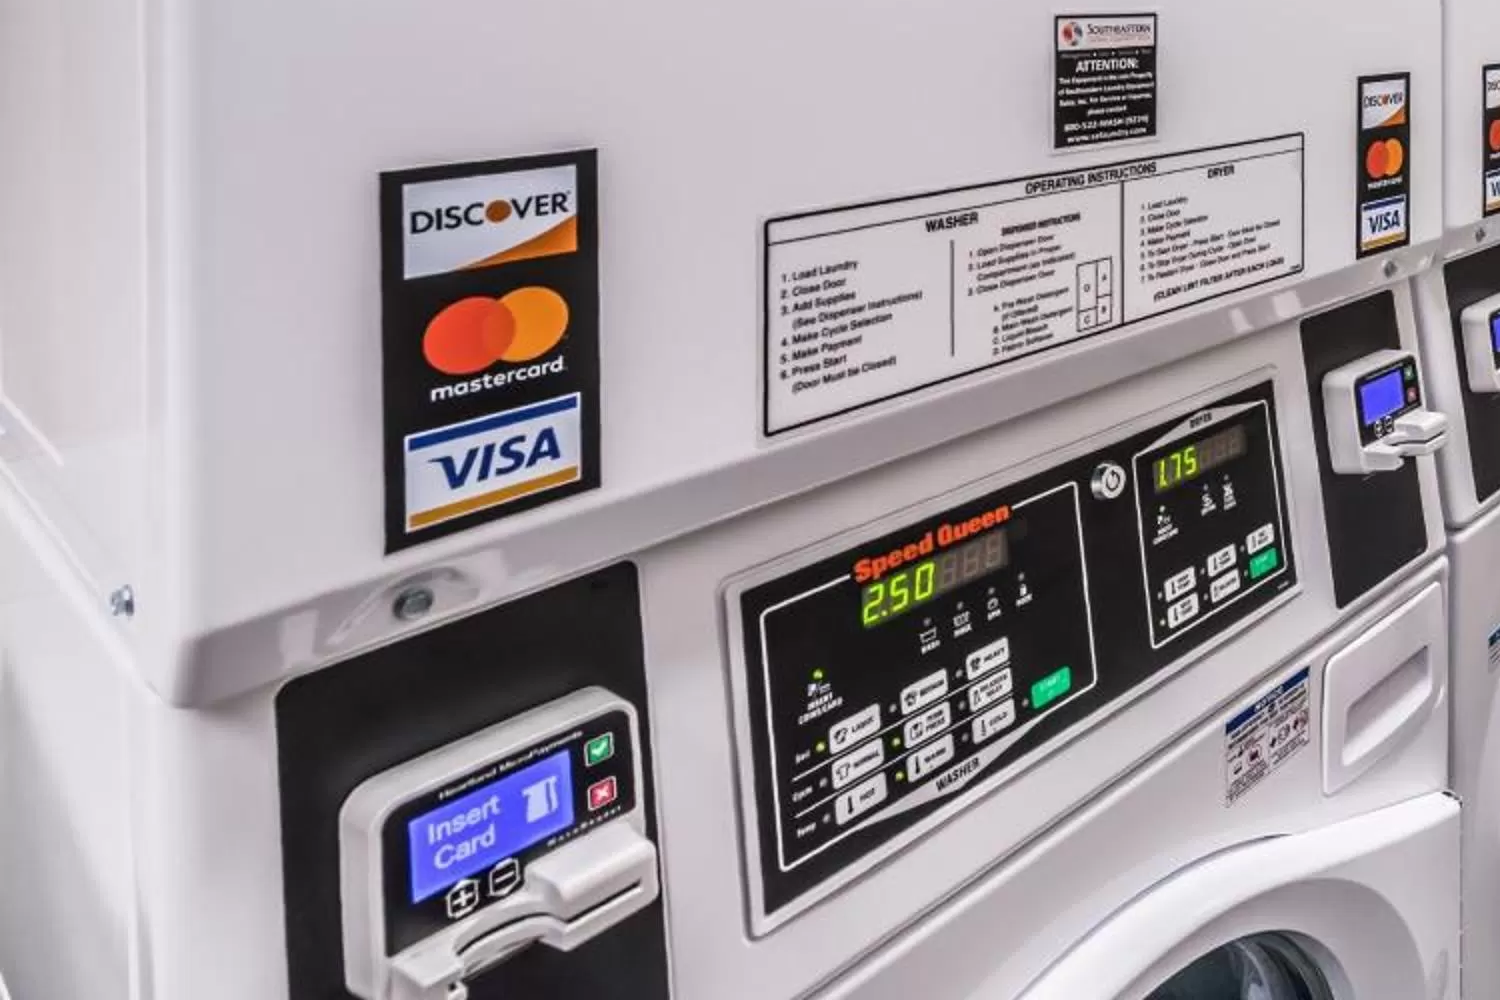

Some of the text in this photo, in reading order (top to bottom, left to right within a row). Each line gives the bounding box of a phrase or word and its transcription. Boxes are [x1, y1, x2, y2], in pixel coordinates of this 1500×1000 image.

[1076, 58, 1139, 73] ATTENTION:
[1025, 162, 1157, 195] OPERATING INSTRUCTIONS
[1207, 164, 1235, 179] DRYER
[410, 191, 570, 235] DISCOVER
[925, 212, 979, 232] WASHER
[1369, 210, 1400, 234] VISA
[782, 261, 859, 282] 1. Load Laundry
[792, 284, 820, 296] Close
[823, 279, 847, 290] Door
[793, 300, 813, 311] Add
[815, 292, 856, 308] Supplies
[792, 332, 819, 344] Make
[821, 324, 848, 338] Cycle
[850, 313, 892, 330] Selection
[792, 347, 819, 360] Make
[821, 335, 863, 352] Payment
[431, 356, 564, 401] mastercard
[792, 363, 820, 376] Press
[823, 354, 847, 368] Start
[427, 426, 561, 491] VISA
[854, 504, 1011, 584] Speed Queen
[863, 561, 935, 627] 2.50
[935, 757, 979, 792] WASHER
[859, 787, 876, 802] HOT
[428, 795, 501, 845] Insert
[433, 823, 496, 869] Card
